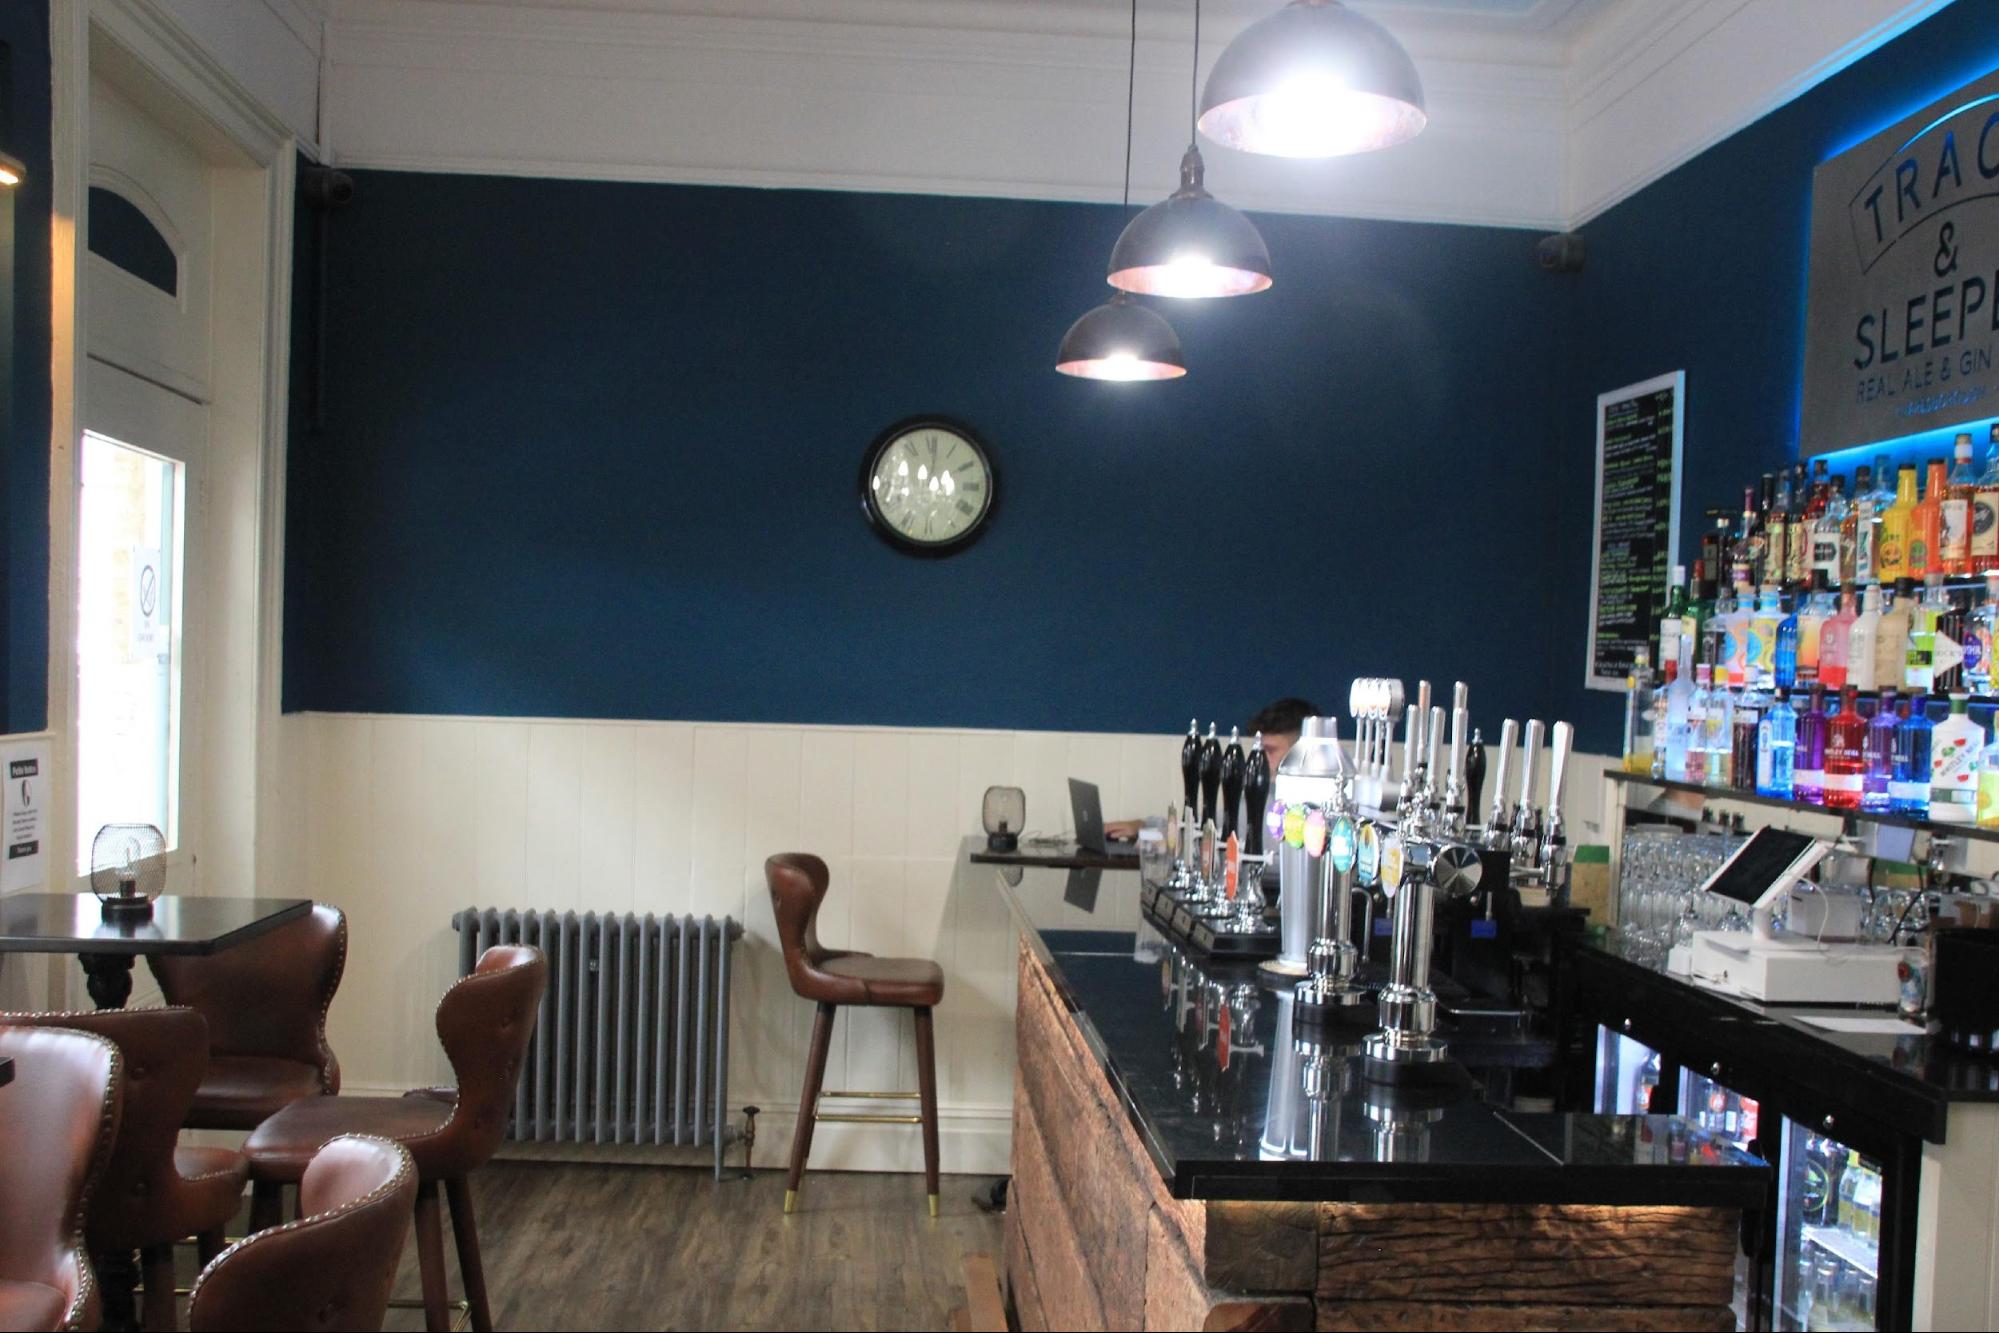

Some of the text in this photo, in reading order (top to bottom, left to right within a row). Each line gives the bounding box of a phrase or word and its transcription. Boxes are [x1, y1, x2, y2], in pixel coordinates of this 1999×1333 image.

[1934, 221, 1957, 278] &
[1856, 375, 1896, 403] REAL
[1902, 361, 1934, 391] ALE
[1940, 356, 1952, 381] &
[1960, 344, 1993, 376] GIN
